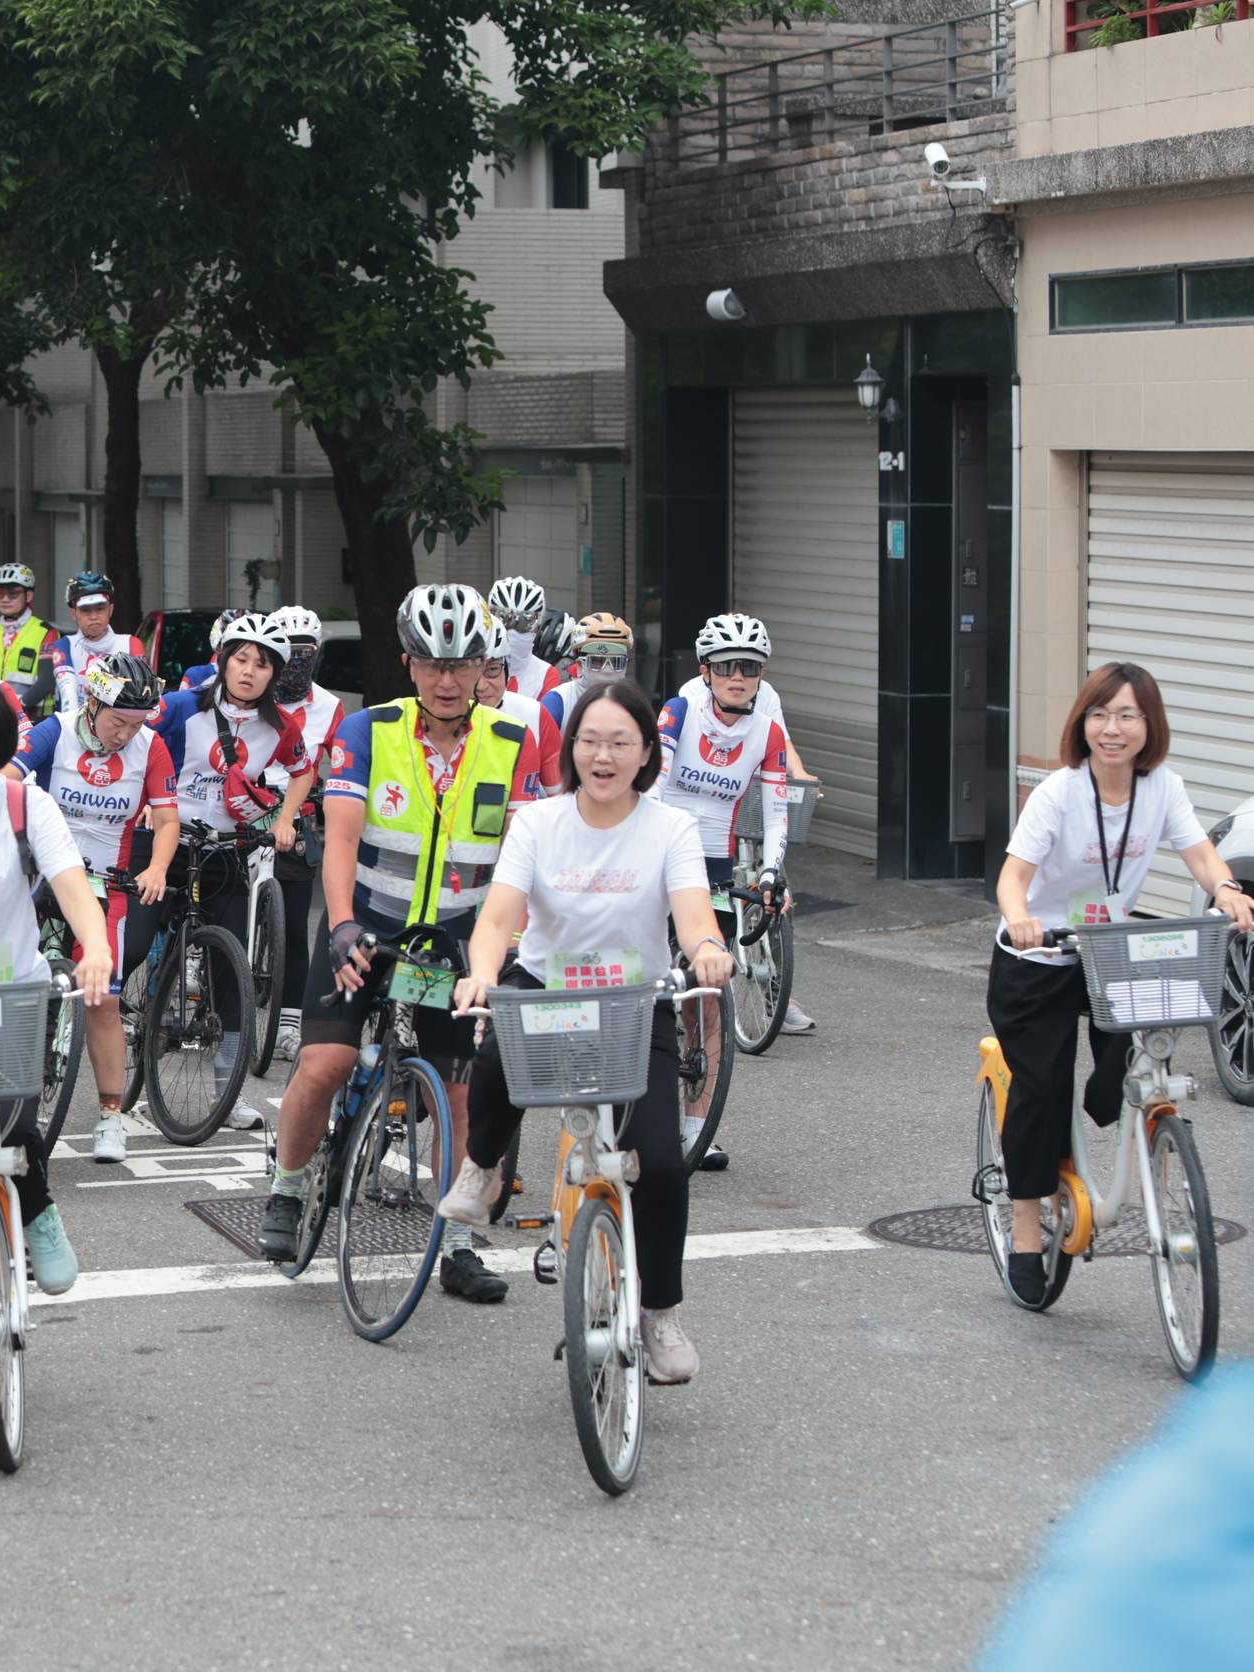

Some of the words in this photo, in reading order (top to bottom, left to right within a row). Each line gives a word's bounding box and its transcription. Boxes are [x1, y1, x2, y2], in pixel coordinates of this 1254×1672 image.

[326, 781, 352, 791] 025
[680, 765, 742, 791] TAIWAN
[60, 786, 130, 810] TAIWAN
